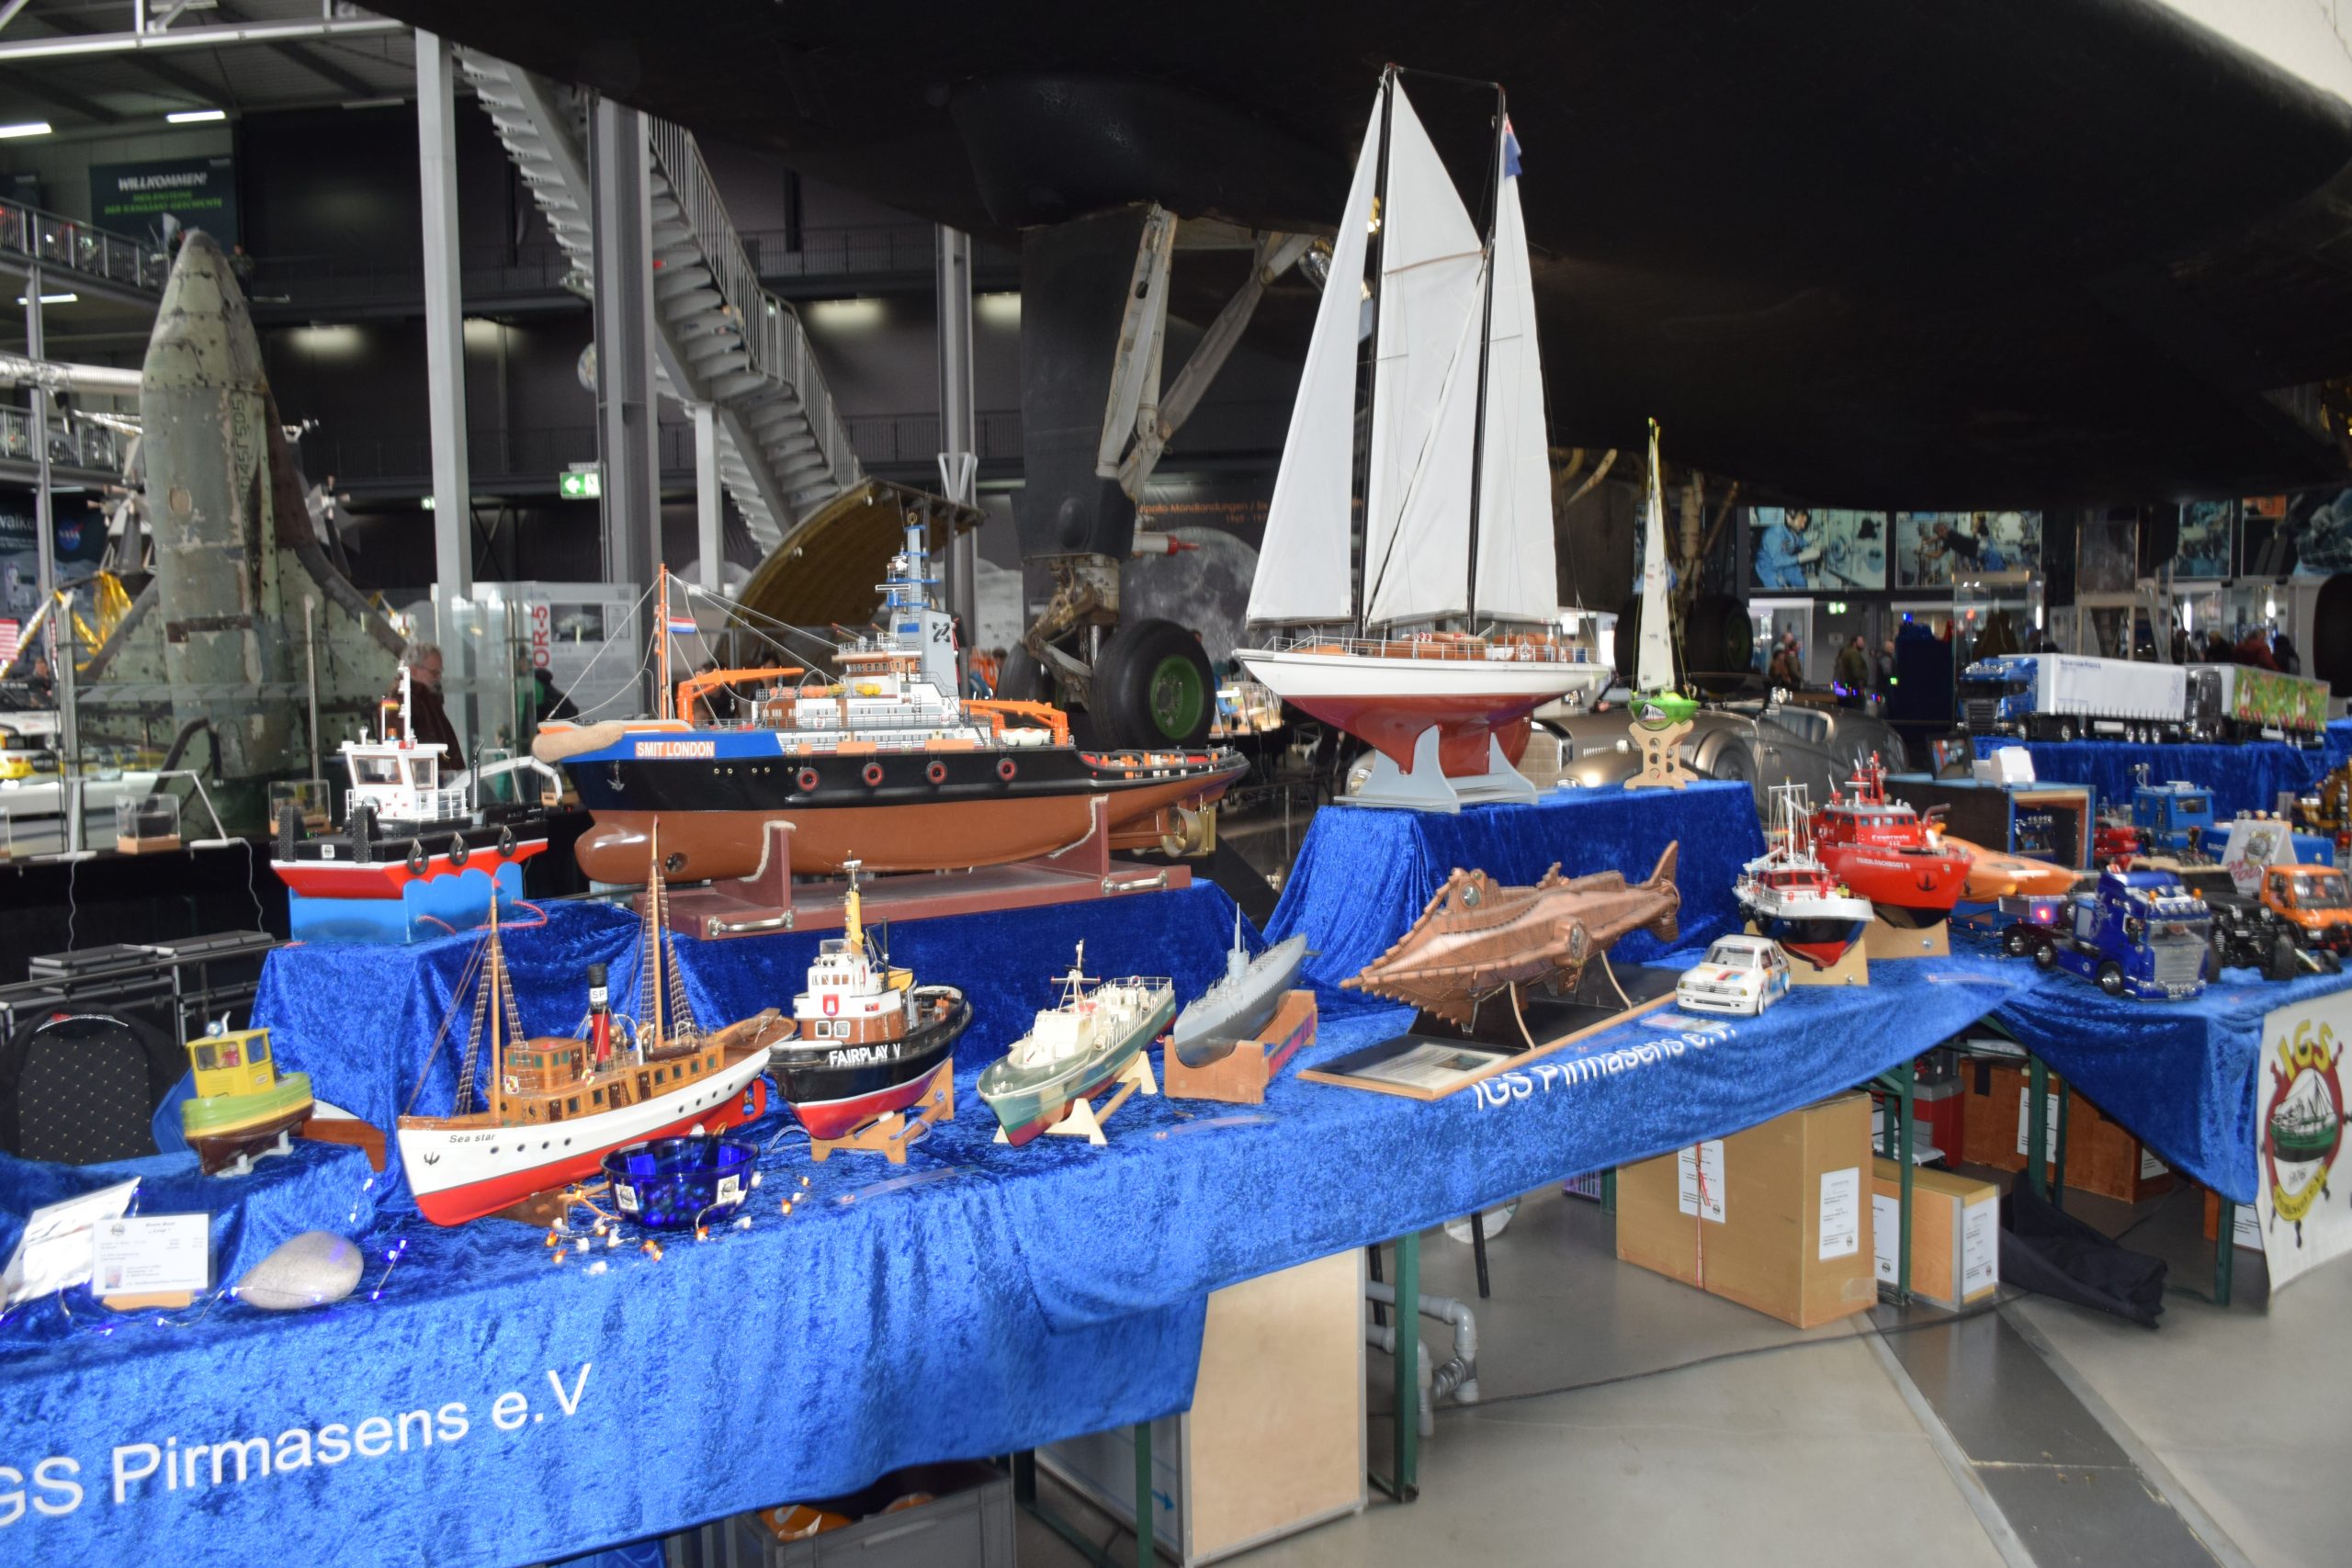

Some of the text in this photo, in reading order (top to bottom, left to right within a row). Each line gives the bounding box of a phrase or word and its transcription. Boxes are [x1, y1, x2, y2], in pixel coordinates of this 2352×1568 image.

[118, 171, 208, 191] WILLKOMMEN!
[637, 741, 714, 757] SMIT LONDON
[593, 989, 605, 999] SP
[829, 1043, 900, 1068] FAIRPLAY V
[2278, 1019, 2333, 1083] IGS
[1472, 1071, 1533, 1110] IGS
[1531, 1038, 1684, 1092] Pirmasens
[449, 1134, 496, 1143] Sea star
[112, 1401, 470, 1505] Pirmasens
[492, 1363, 593, 1431] e.V
